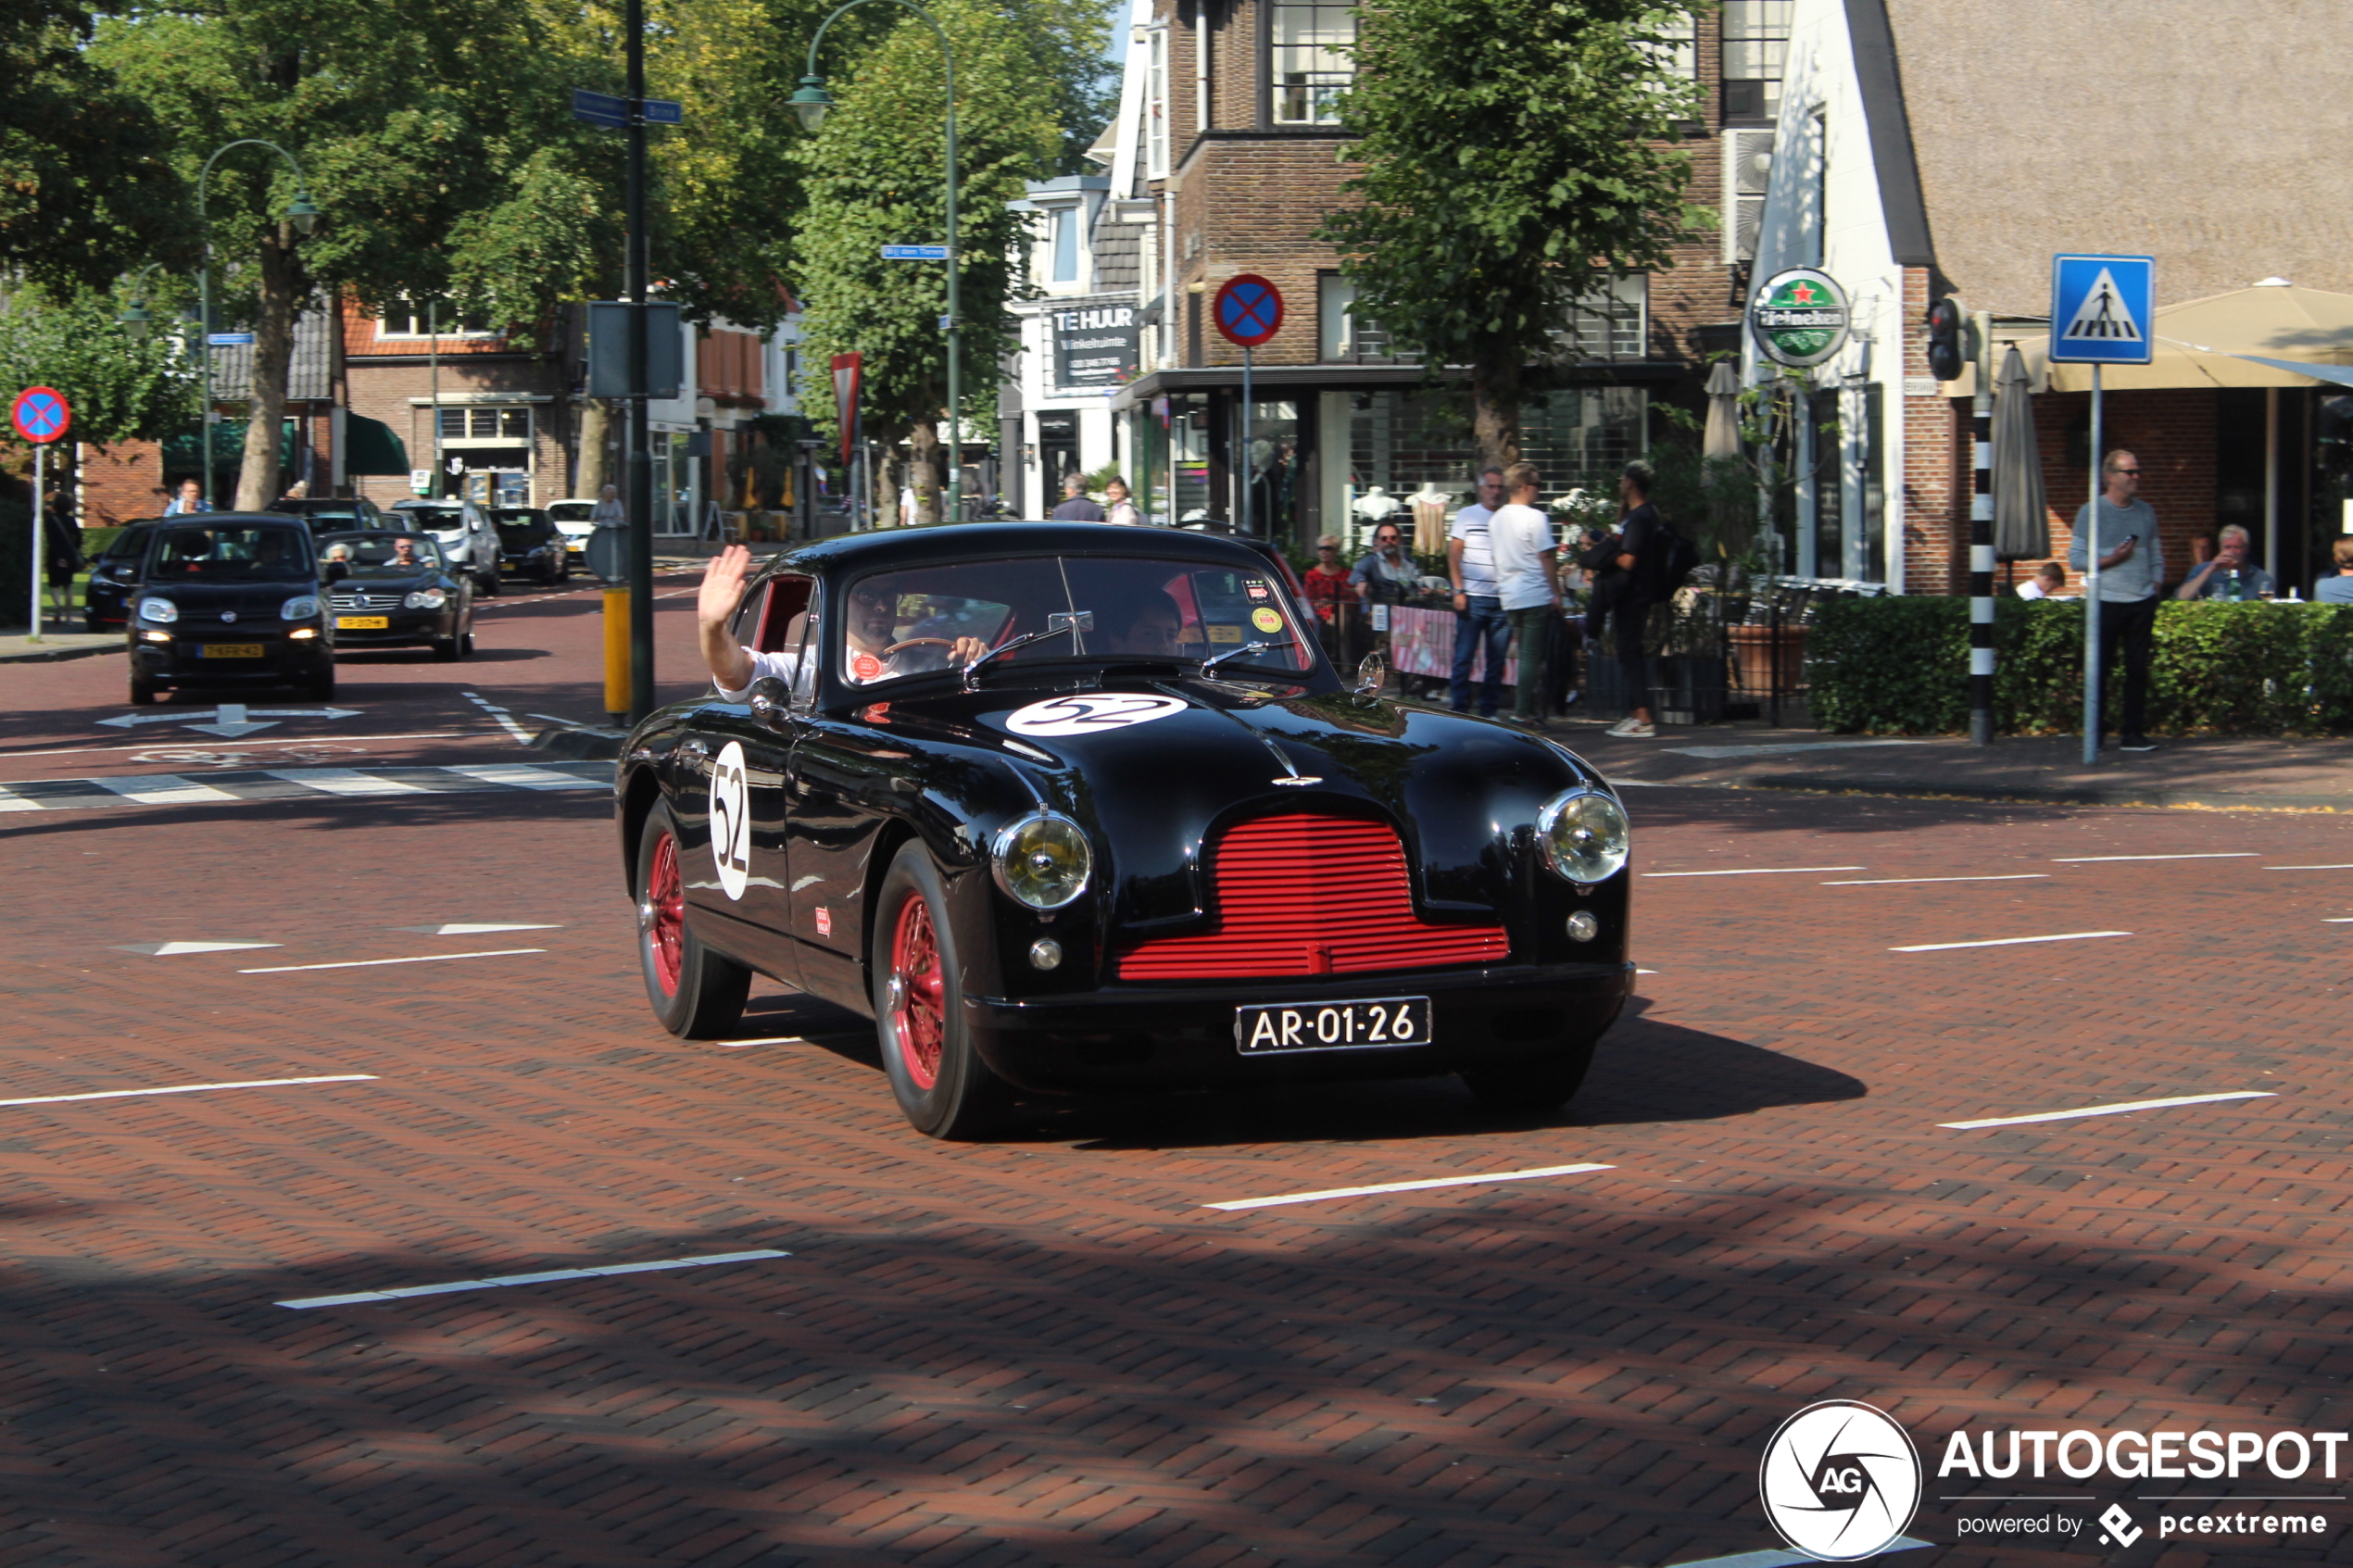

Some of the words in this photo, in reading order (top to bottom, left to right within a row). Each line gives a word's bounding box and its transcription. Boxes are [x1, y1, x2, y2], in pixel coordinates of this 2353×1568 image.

[1053, 311, 1079, 332] TE
[1080, 307, 1133, 330] HUUR
[1759, 309, 1843, 326] Heineken
[1060, 336, 1127, 351] Winkelruimte
[1020, 696, 1173, 726] 52
[714, 763, 747, 873] 52
[1250, 1004, 1415, 1048] AR-01-26
